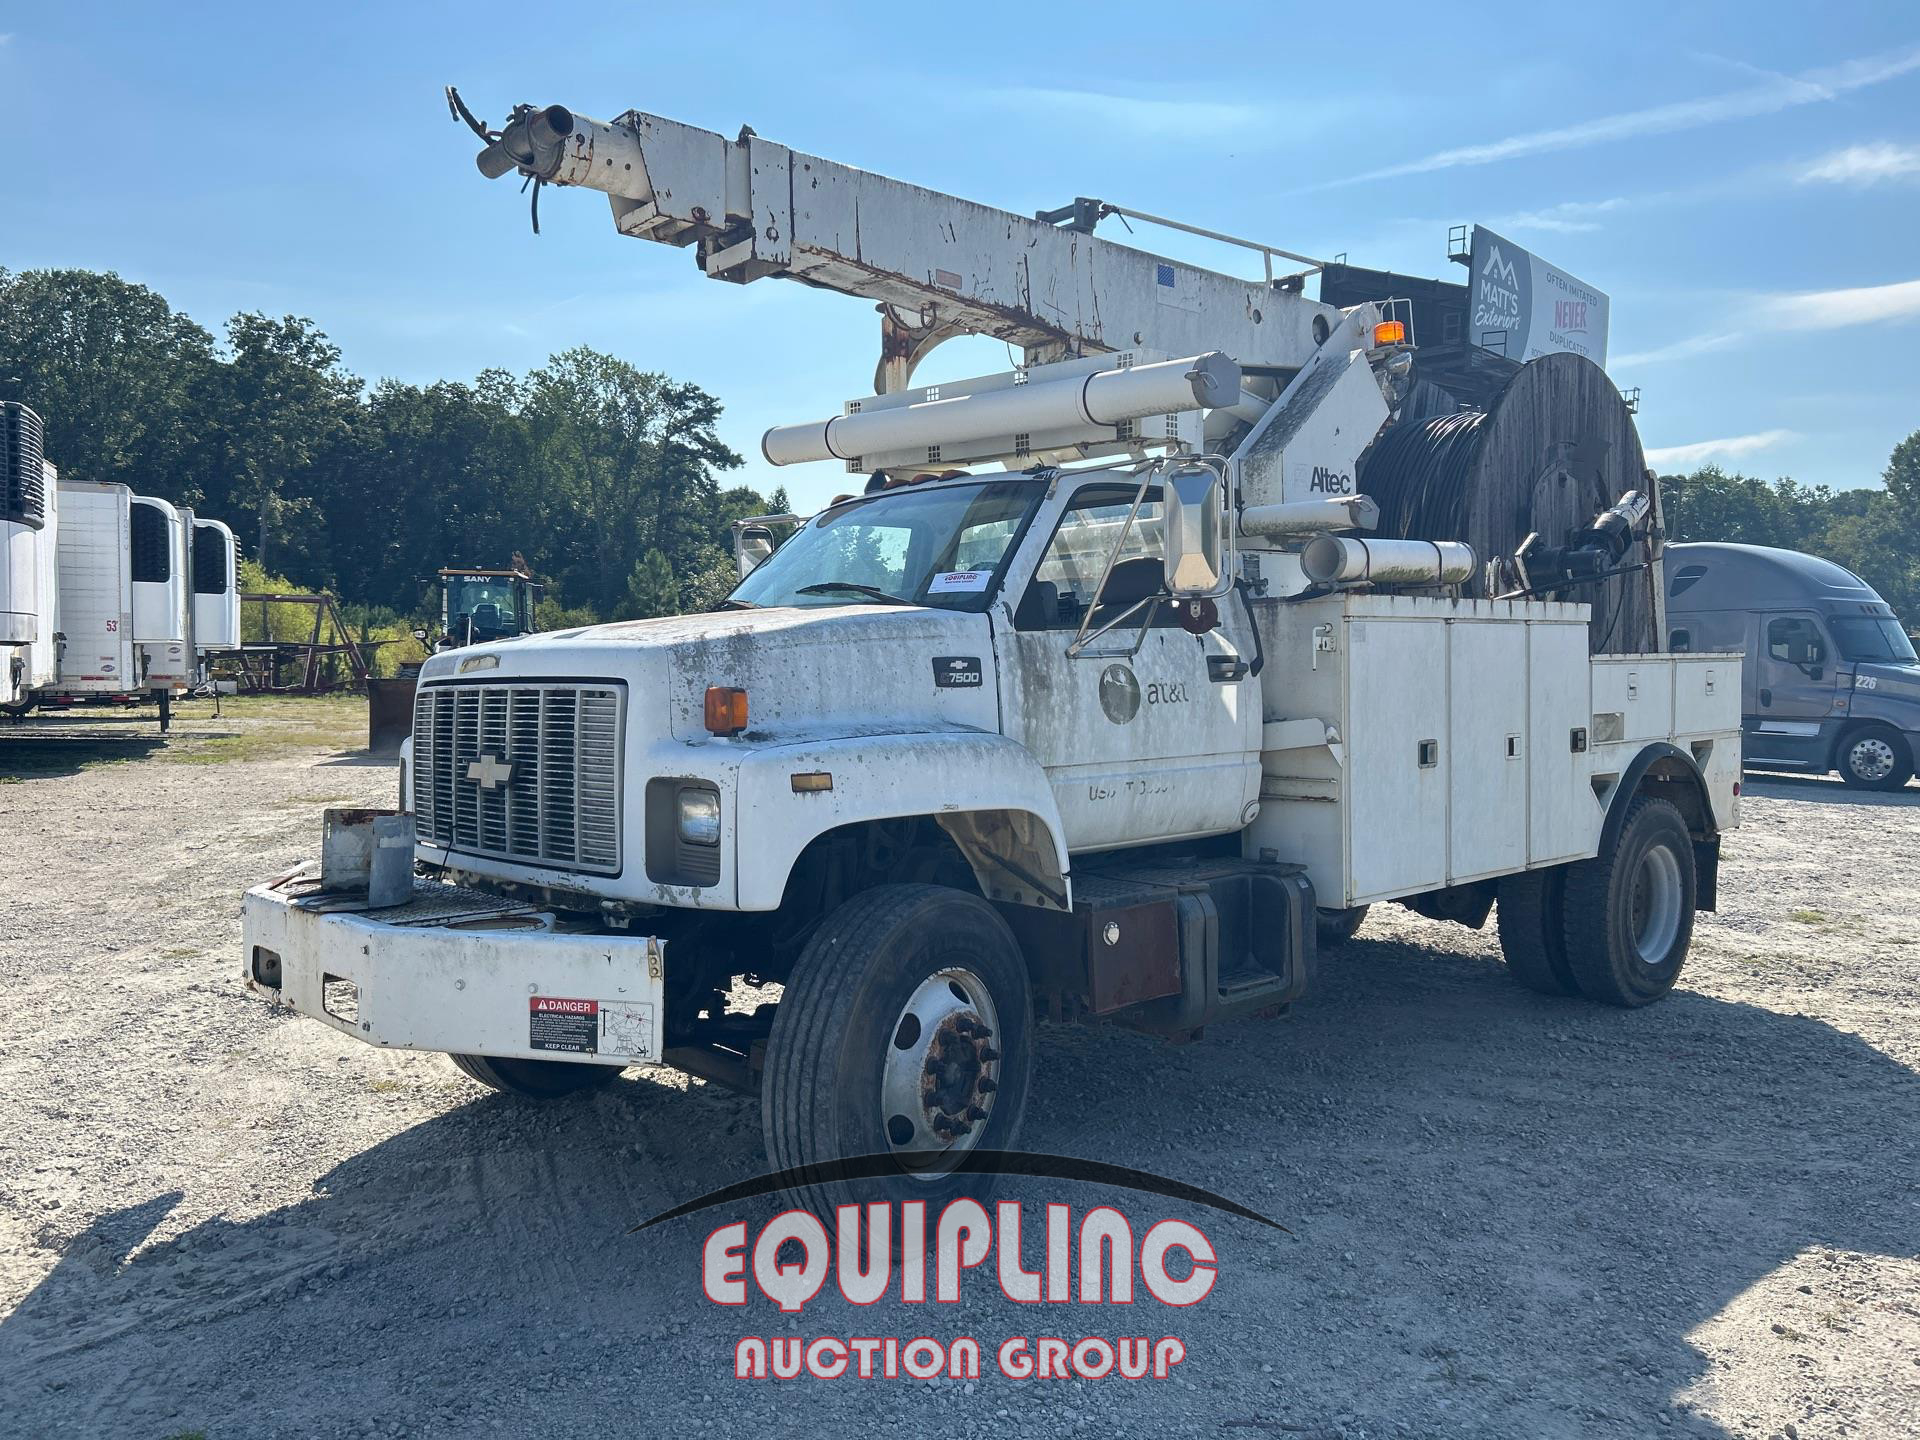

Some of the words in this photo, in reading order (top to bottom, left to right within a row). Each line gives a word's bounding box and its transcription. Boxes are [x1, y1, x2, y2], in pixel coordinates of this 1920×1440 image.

[1480, 279, 1518, 315] MATT'S
[1546, 272, 1568, 292] OFTEN
[1569, 284, 1598, 306] IMITATED
[1554, 300, 1587, 329] NEVER
[1310, 466, 1351, 494] Altec
[463, 575, 492, 583] SANY
[1856, 674, 1878, 690] 226
[549, 1000, 591, 1012] DANGER
